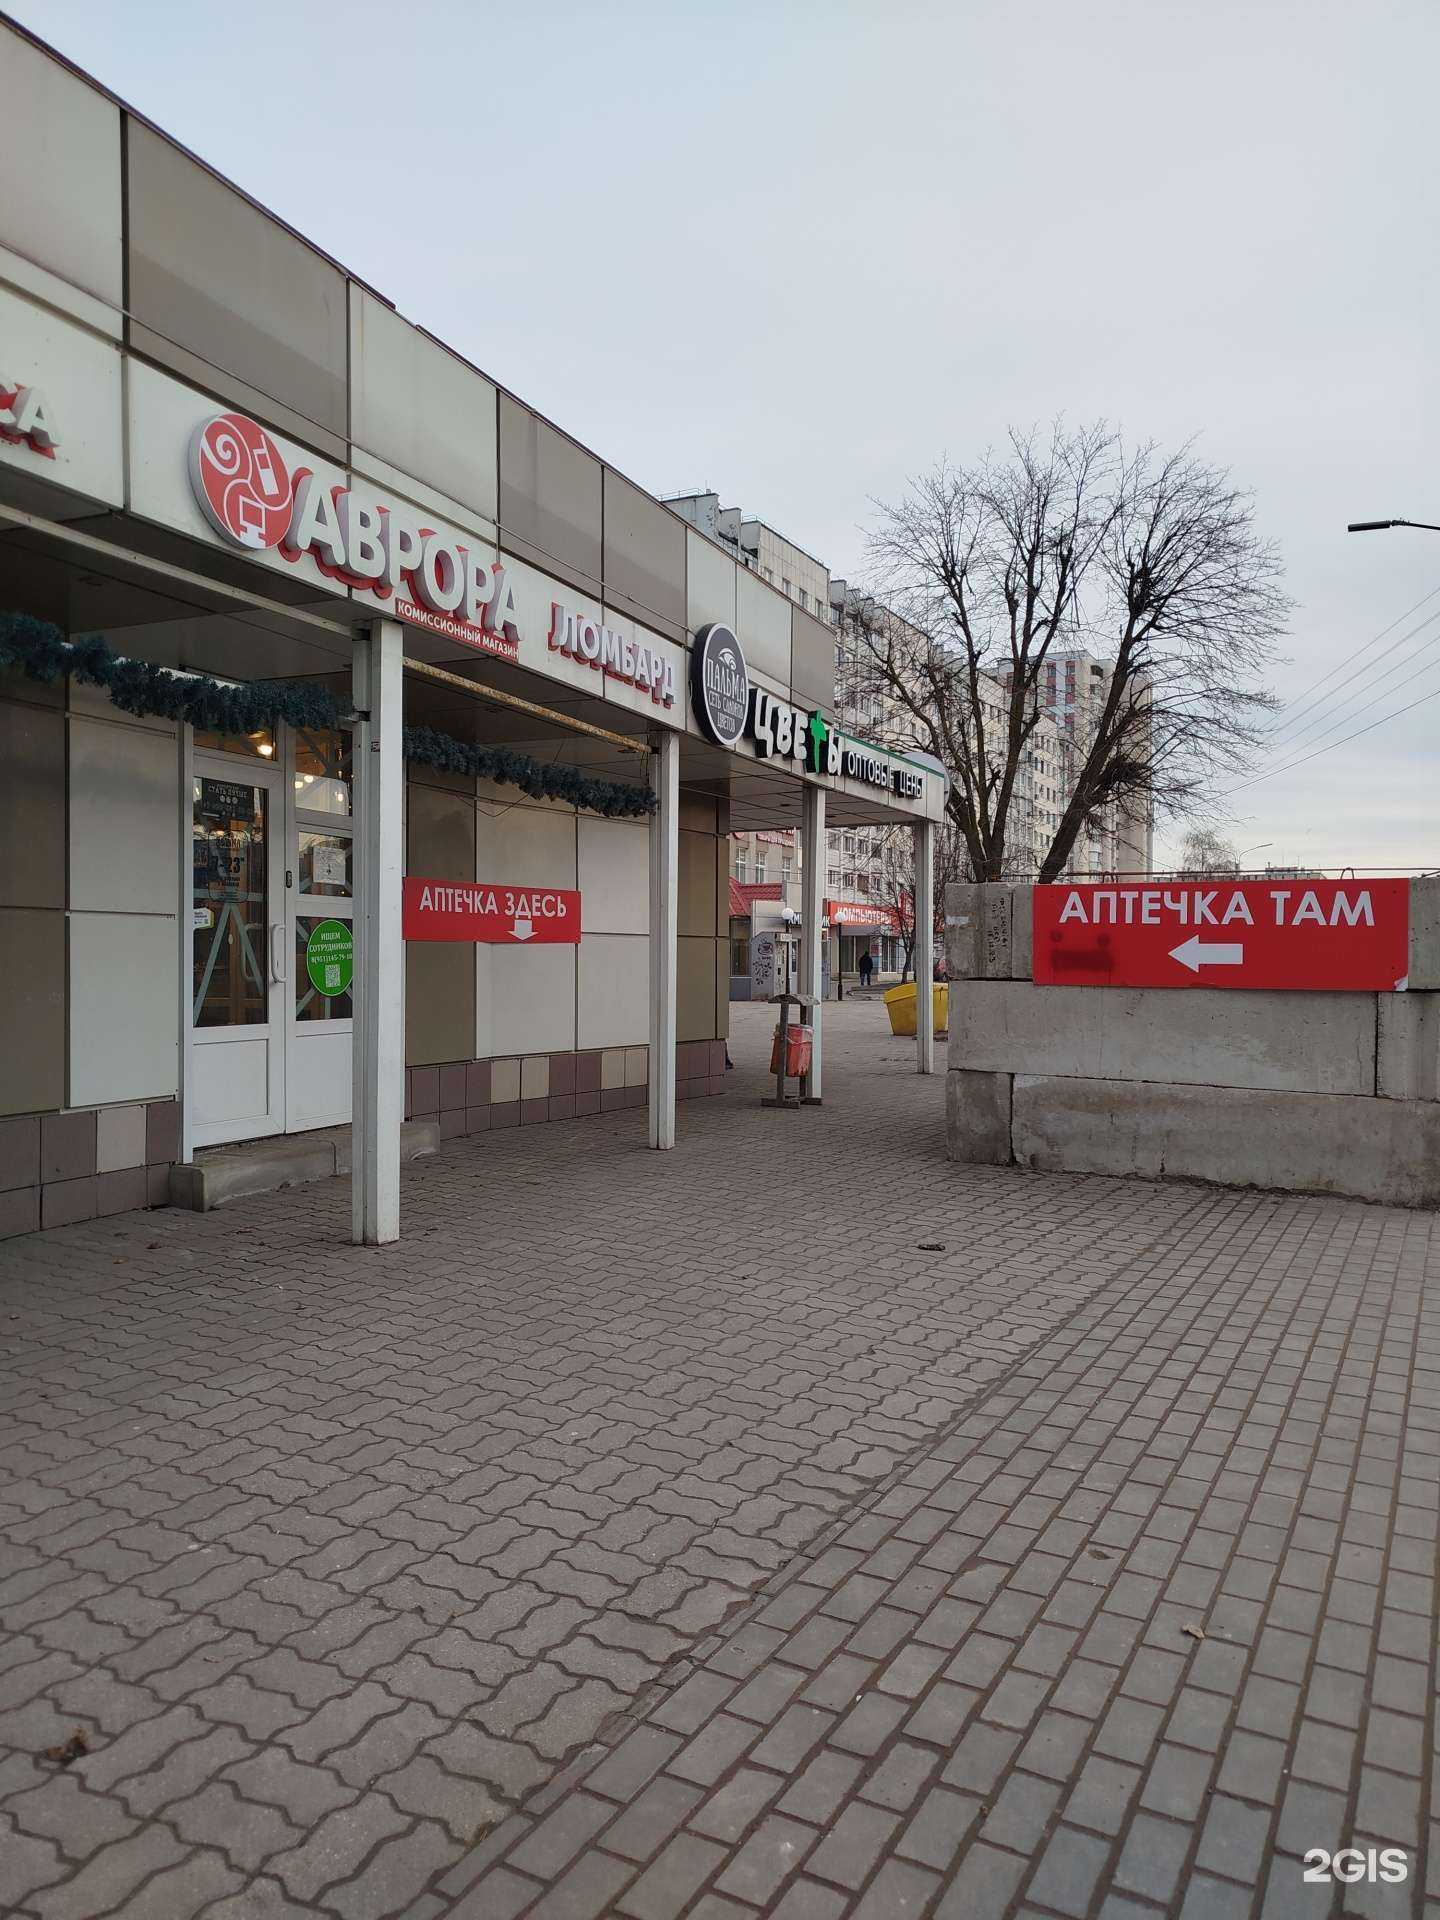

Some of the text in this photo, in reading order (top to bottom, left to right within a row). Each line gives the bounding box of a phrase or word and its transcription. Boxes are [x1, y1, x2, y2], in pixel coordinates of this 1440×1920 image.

[292, 470, 524, 642] АВРОРА
[397, 601, 519, 659] КОМИССИОННЫЙ МАГАЗИН
[549, 602, 676, 706] ЛОМБАРД
[706, 658, 746, 704] ПАЛЬМА
[708, 690, 721, 709] СЕТЬ
[717, 712, 736, 733] ЦВЕТОВ
[753, 687, 924, 798] ЦВЕТЫ ОПТОВЫЕ ЦЕНЫ
[419, 886, 567, 919] АПТЕЧКА ЗДЕСЬ
[1059, 890, 1375, 927] АПТЕЧКА ТАМ
[320, 932, 341, 941] ИЩЕМ
